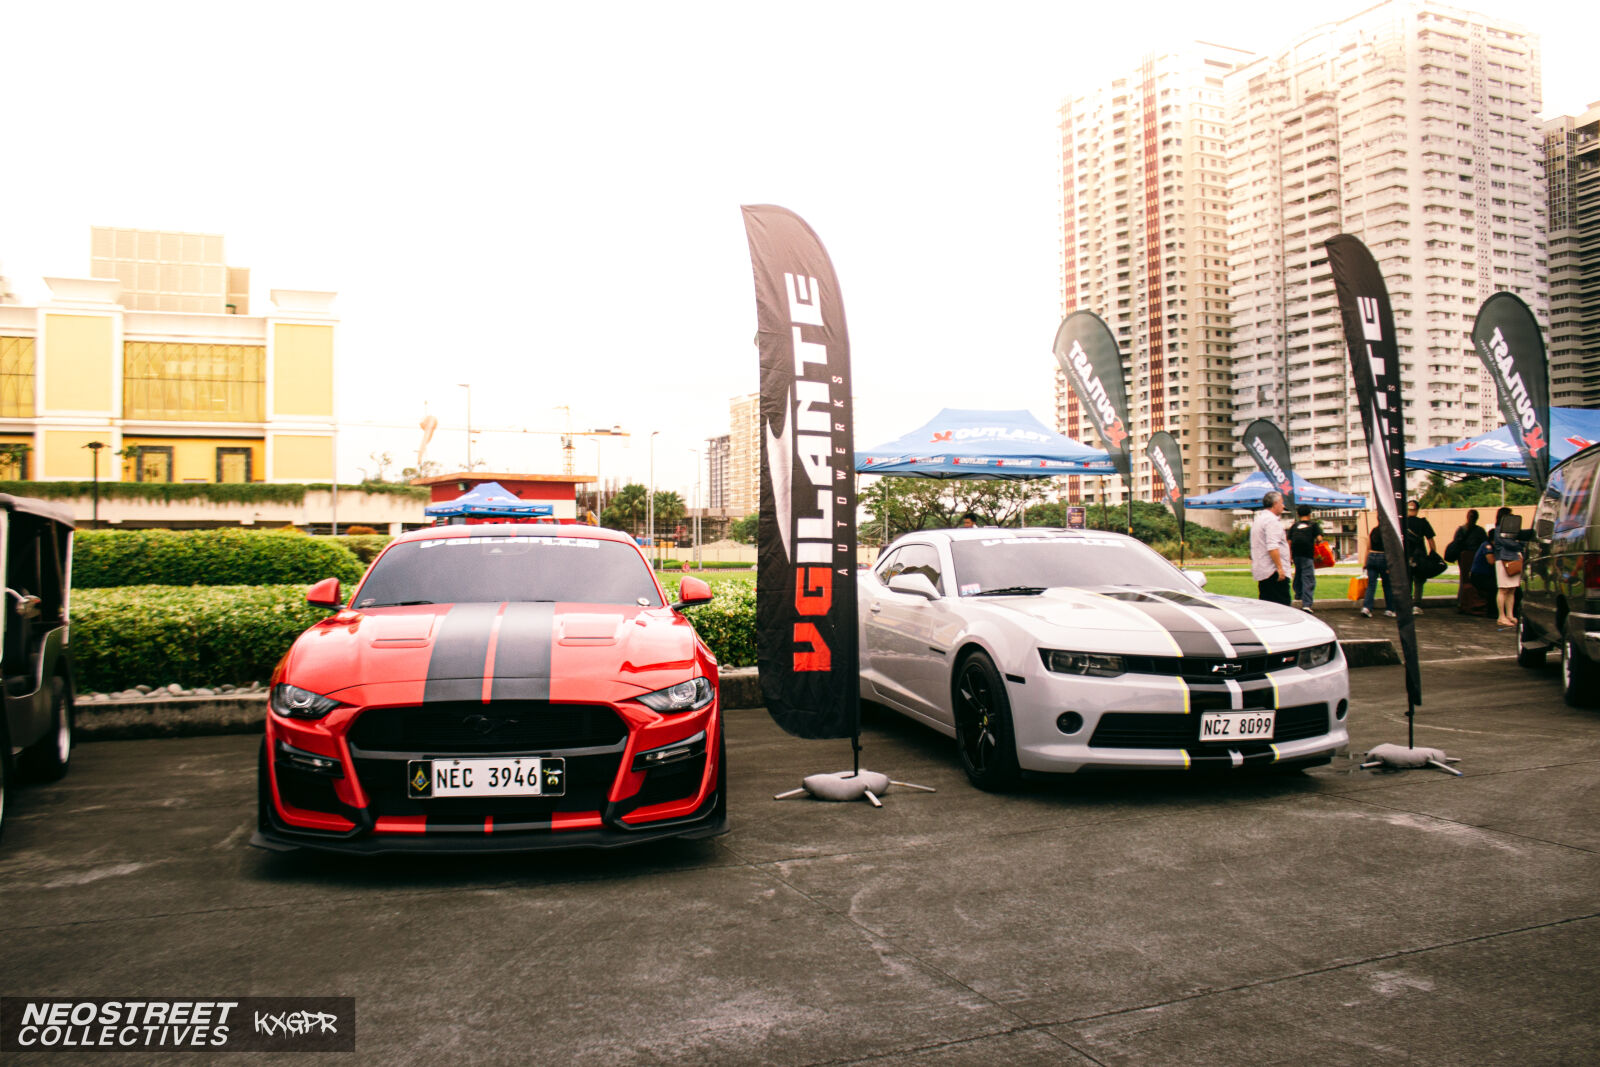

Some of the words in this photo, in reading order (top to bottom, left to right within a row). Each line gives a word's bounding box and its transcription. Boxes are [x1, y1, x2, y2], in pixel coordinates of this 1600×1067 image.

[955, 427, 1051, 443] OUTLAST
[832, 375, 848, 576] AUTOWERKS
[1204, 719, 1230, 735] NCZ
[1239, 718, 1271, 734] 8099
[436, 768, 473, 788] NEC
[488, 767, 537, 787] 3946
